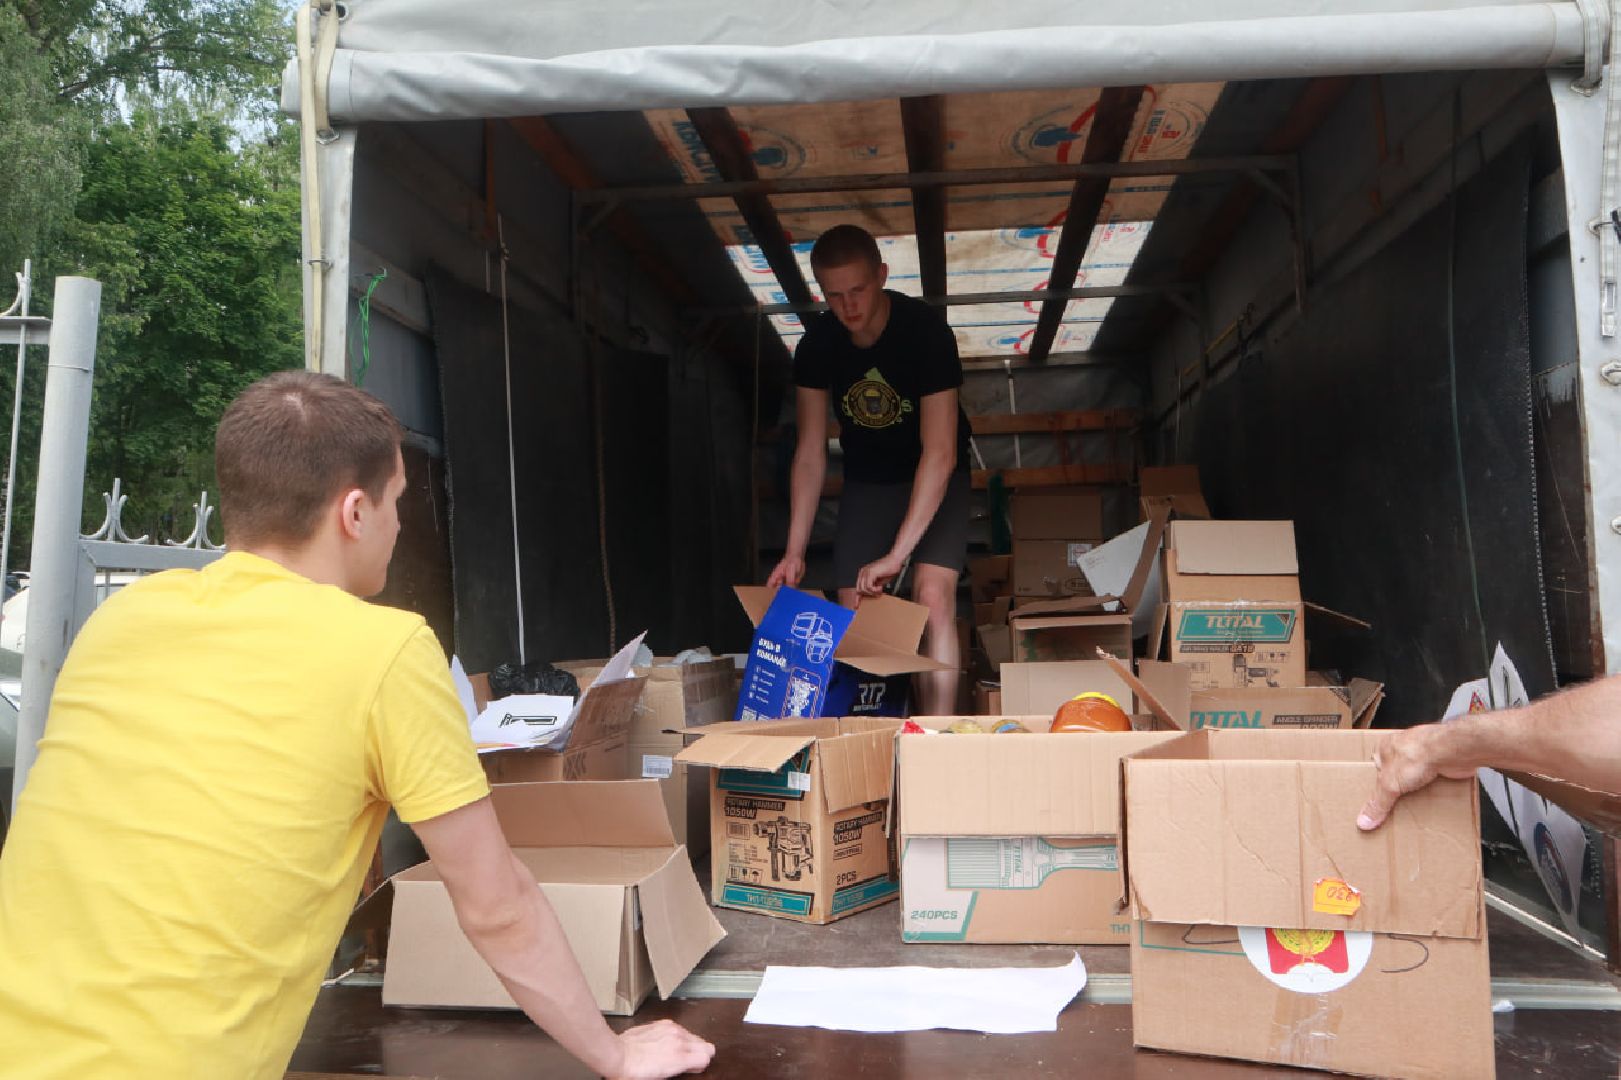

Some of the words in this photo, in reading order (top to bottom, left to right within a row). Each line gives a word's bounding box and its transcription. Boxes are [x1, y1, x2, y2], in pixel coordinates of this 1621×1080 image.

[1206, 615, 1264, 628] TOTAL
[725, 806, 756, 818] 1050W
[833, 828, 861, 844] 1050W
[836, 871, 857, 886] 2PCS
[910, 910, 958, 920] 240PCS
